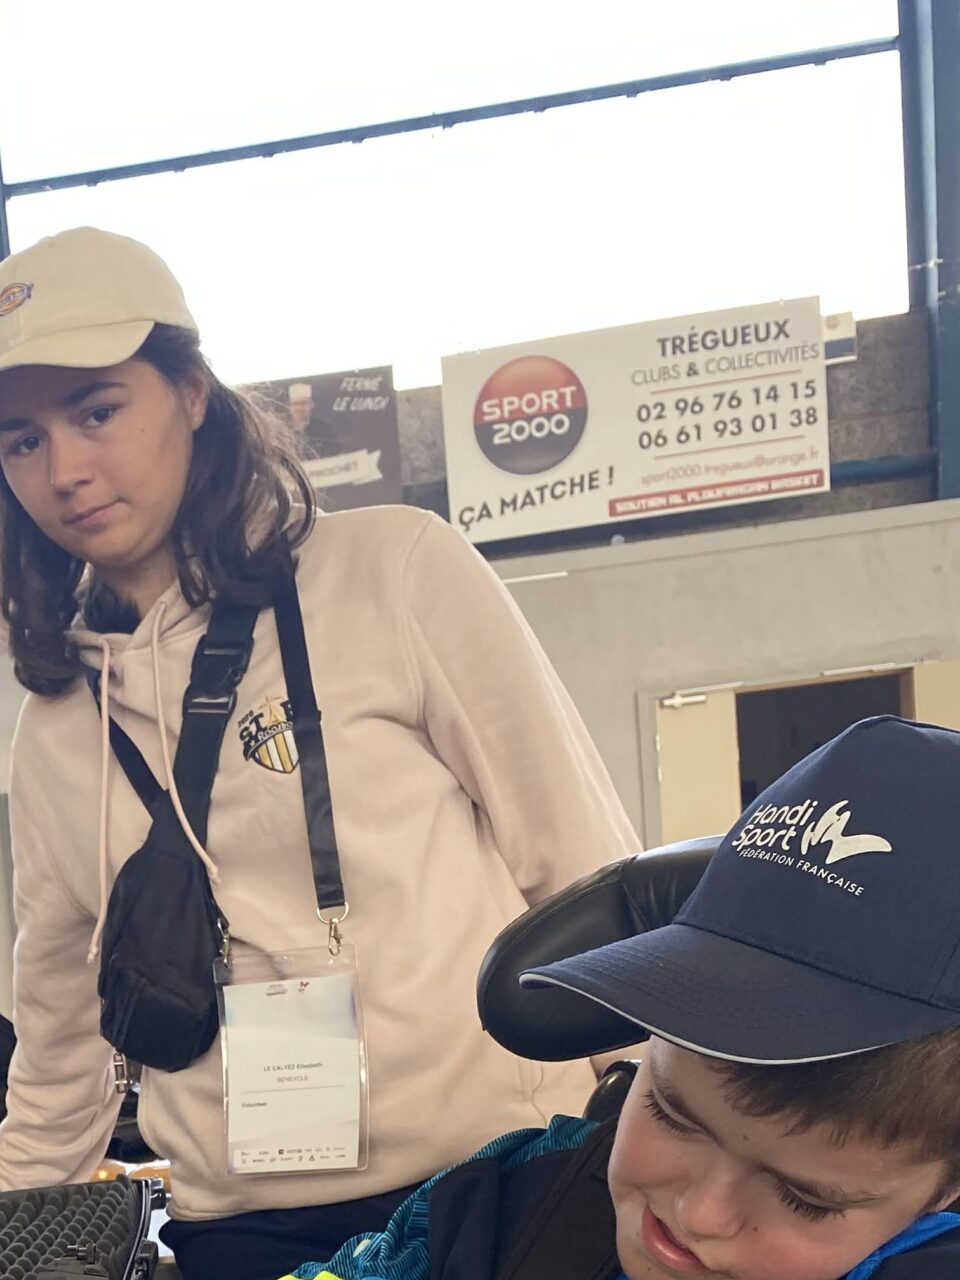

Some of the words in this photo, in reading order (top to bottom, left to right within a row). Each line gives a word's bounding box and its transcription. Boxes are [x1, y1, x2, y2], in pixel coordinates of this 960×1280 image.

[657, 318, 791, 357] TRÉGUEUX
[631, 363, 681, 386] CLUBS
[686, 362, 700, 377] &
[704, 342, 820, 374] COLLECTIVITÉS
[481, 386, 577, 421] SPORT
[636, 402, 667, 423] 02
[674, 395, 704, 416] 96
[712, 390, 742, 411] 76
[752, 385, 779, 405] 14
[790, 379, 817, 400] 15
[492, 413, 570, 445] 2000
[638, 428, 668, 450] 06
[676, 424, 702, 444] 61
[713, 417, 743, 438] 93
[751, 412, 777, 433] 01
[789, 406, 818, 428] 38
[458, 501, 493, 532] ÇA
[500, 470, 600, 515] MATCHE
[746, 799, 819, 827] Handi
[731, 824, 797, 852] Sport
[739, 847, 794, 867] FÉDÉRATION
[796, 859, 865, 897] FRANÇAISE
